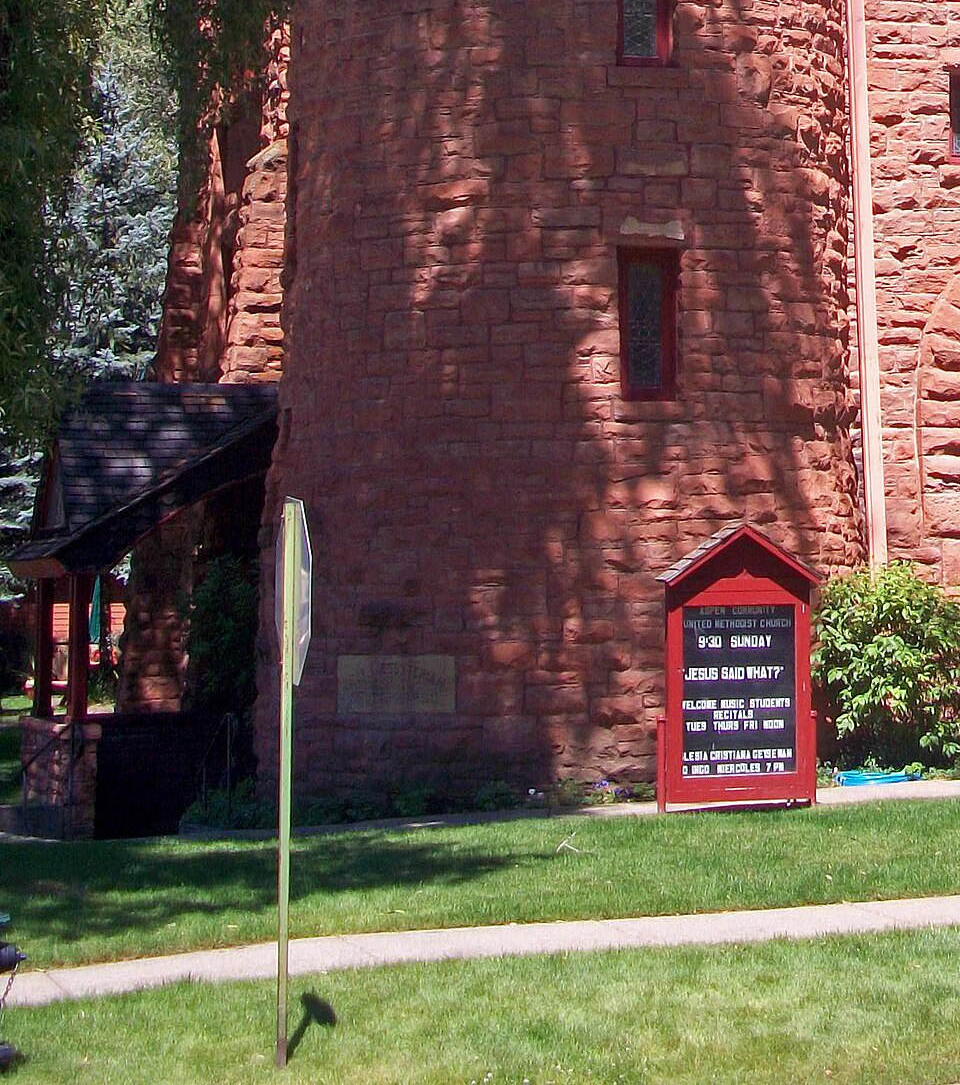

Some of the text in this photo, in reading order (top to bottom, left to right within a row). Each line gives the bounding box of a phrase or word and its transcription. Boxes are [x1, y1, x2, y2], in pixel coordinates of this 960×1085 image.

[699, 606, 775, 615] ASPEN COMMUNITY
[683, 618, 792, 629] UNITED METHODIST CHURCH
[698, 634, 772, 648] 9:30 SUNDAY
[721, 666, 745, 680] SAID
[720, 699, 745, 709] MUSIC
[749, 697, 791, 708] STUDENTS
[713, 709, 754, 720] RECITALS
[685, 719, 785, 732] TUES THURS FRI NOON
[710, 749, 751, 760] CRISTIANA
[766, 762, 772, 772] 7
[773, 761, 785, 772] PM
